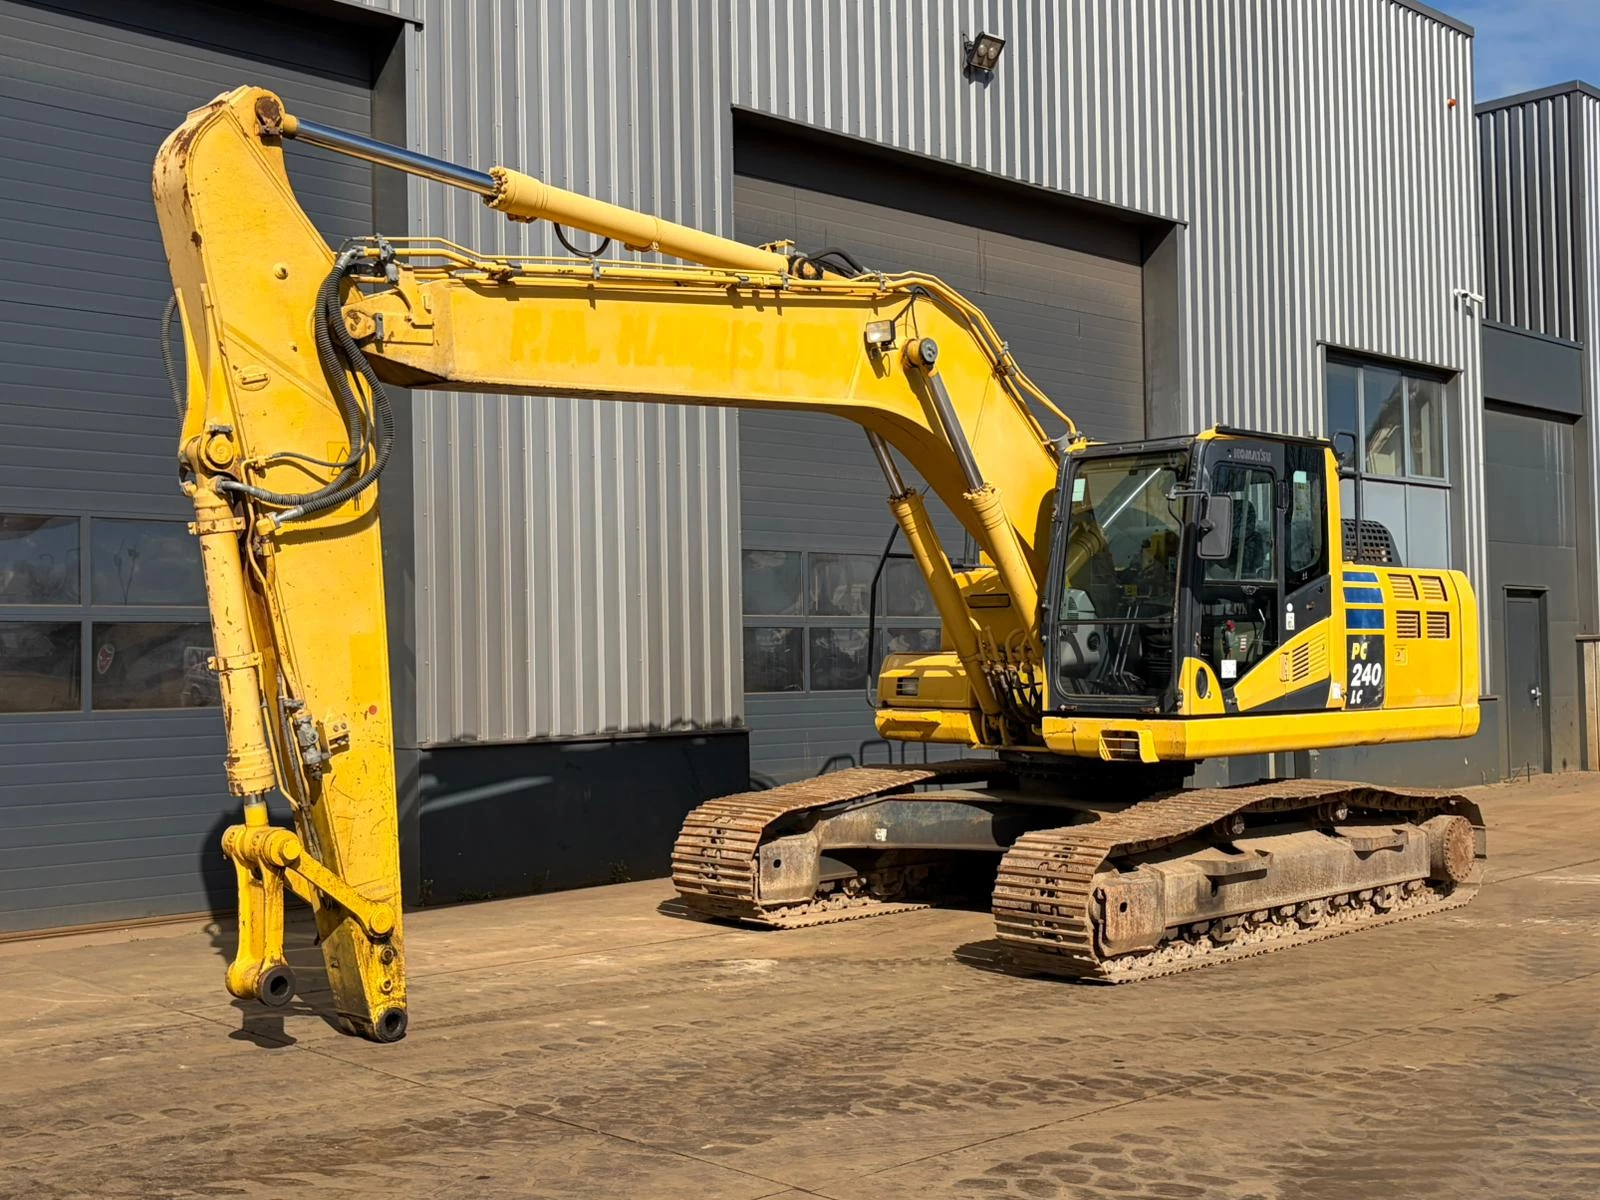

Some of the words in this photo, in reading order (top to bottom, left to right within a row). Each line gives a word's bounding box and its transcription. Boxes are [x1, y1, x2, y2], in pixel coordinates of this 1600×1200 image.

[617, 312, 764, 370] HARIS
[1233, 447, 1272, 462] KOMATSU
[1351, 642, 1368, 660] PC
[1350, 662, 1382, 686] 240
[1350, 689, 1363, 704] LC
